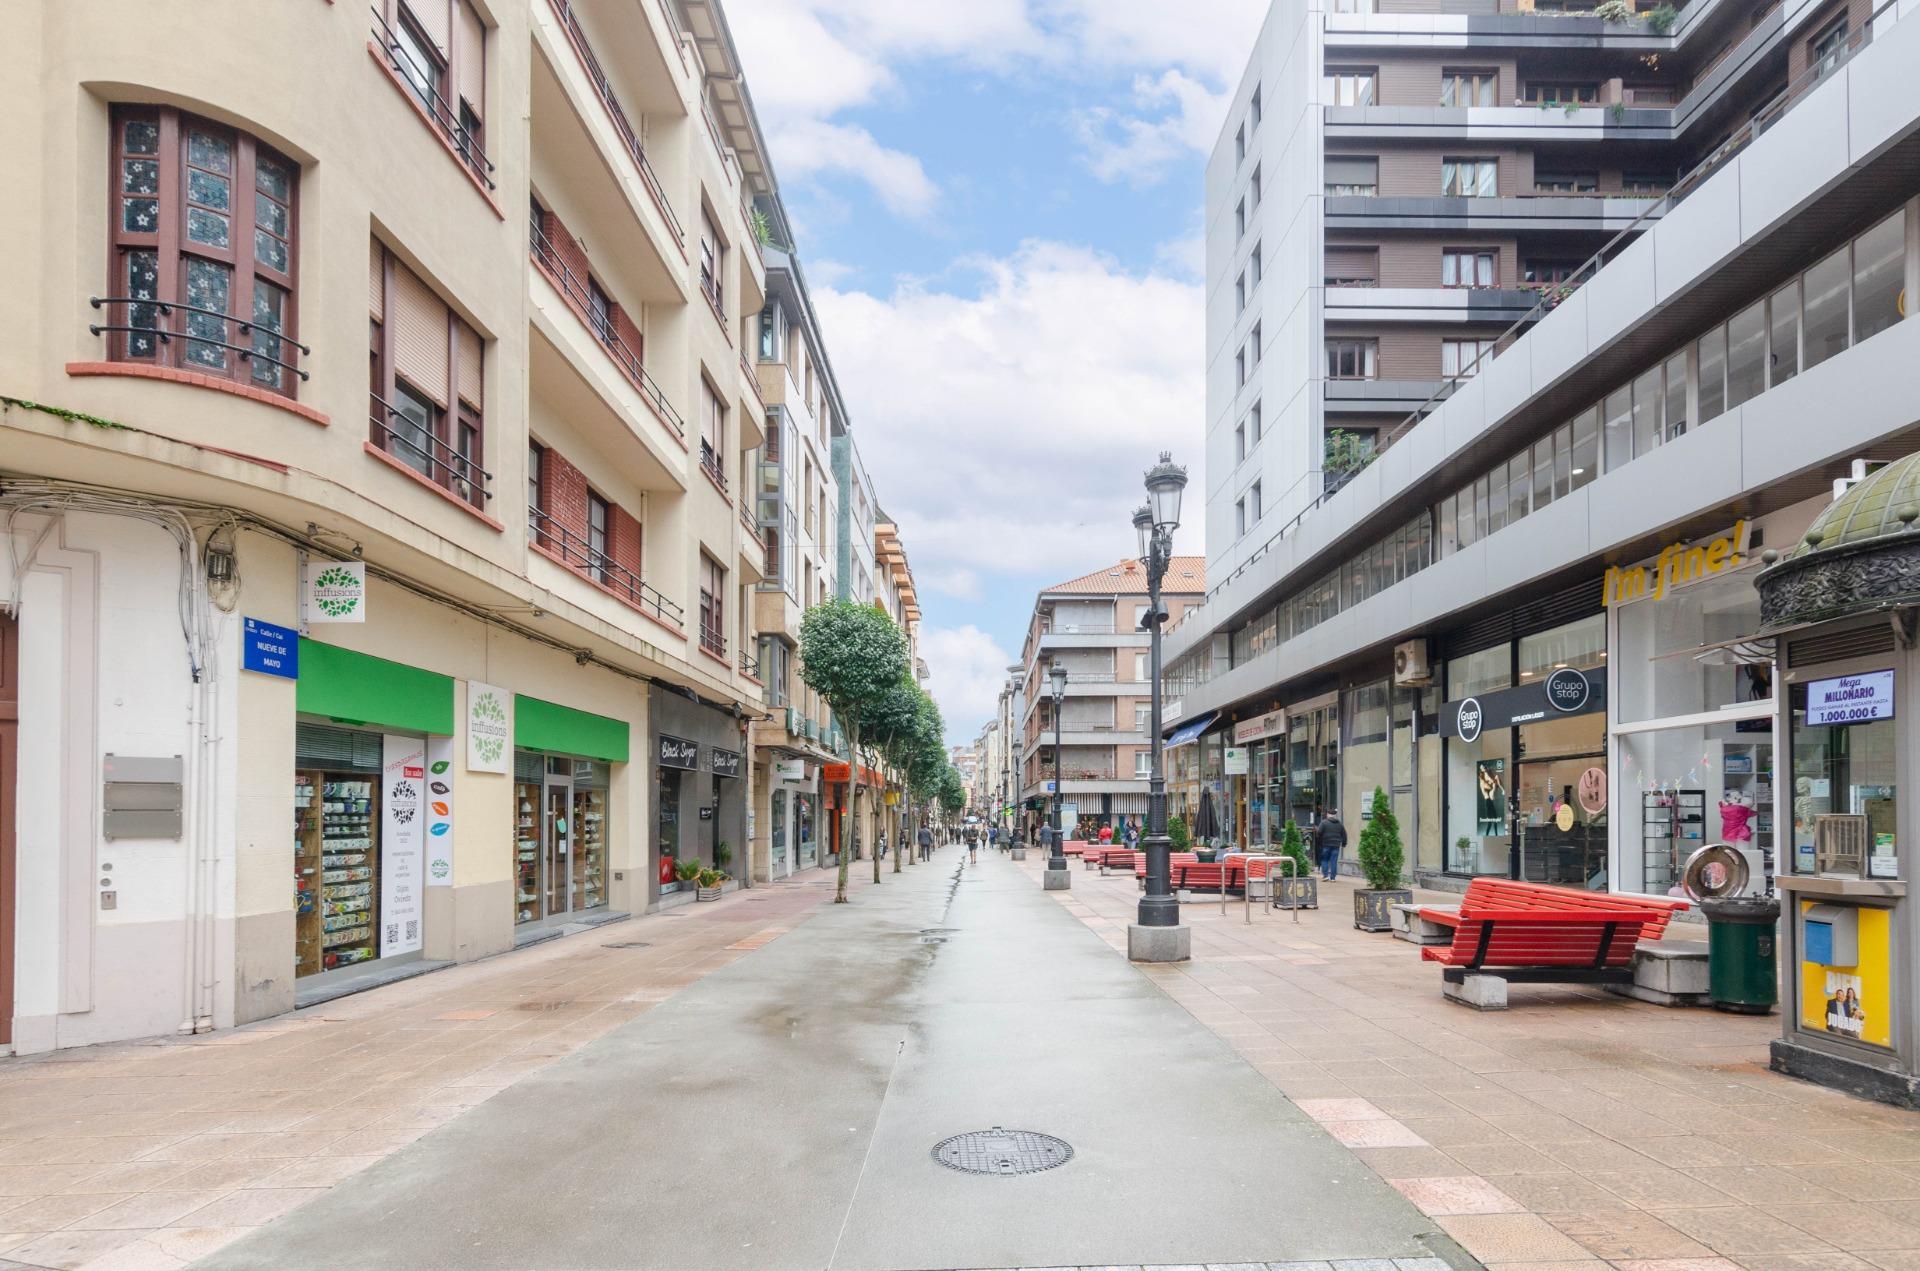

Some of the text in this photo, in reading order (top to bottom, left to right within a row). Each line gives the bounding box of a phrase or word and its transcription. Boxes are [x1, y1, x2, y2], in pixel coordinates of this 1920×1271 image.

[1602, 519, 1745, 607] I'm fine!
[313, 587, 361, 597] inffusions
[257, 641, 287, 656] NUEVE DE
[263, 657, 281, 669] MAYO
[1553, 680, 1583, 692] Grupo
[1838, 678, 1861, 690] Mega
[1556, 688, 1580, 699] stop
[1824, 686, 1875, 703] MILLONARIO
[1460, 711, 1479, 722] Grupo
[1820, 706, 1878, 722] 1.000.000 €
[471, 719, 507, 737] inffusions
[1462, 718, 1477, 730] stop
[662, 741, 697, 766] Black Sugar
[714, 752, 726, 767] Black
